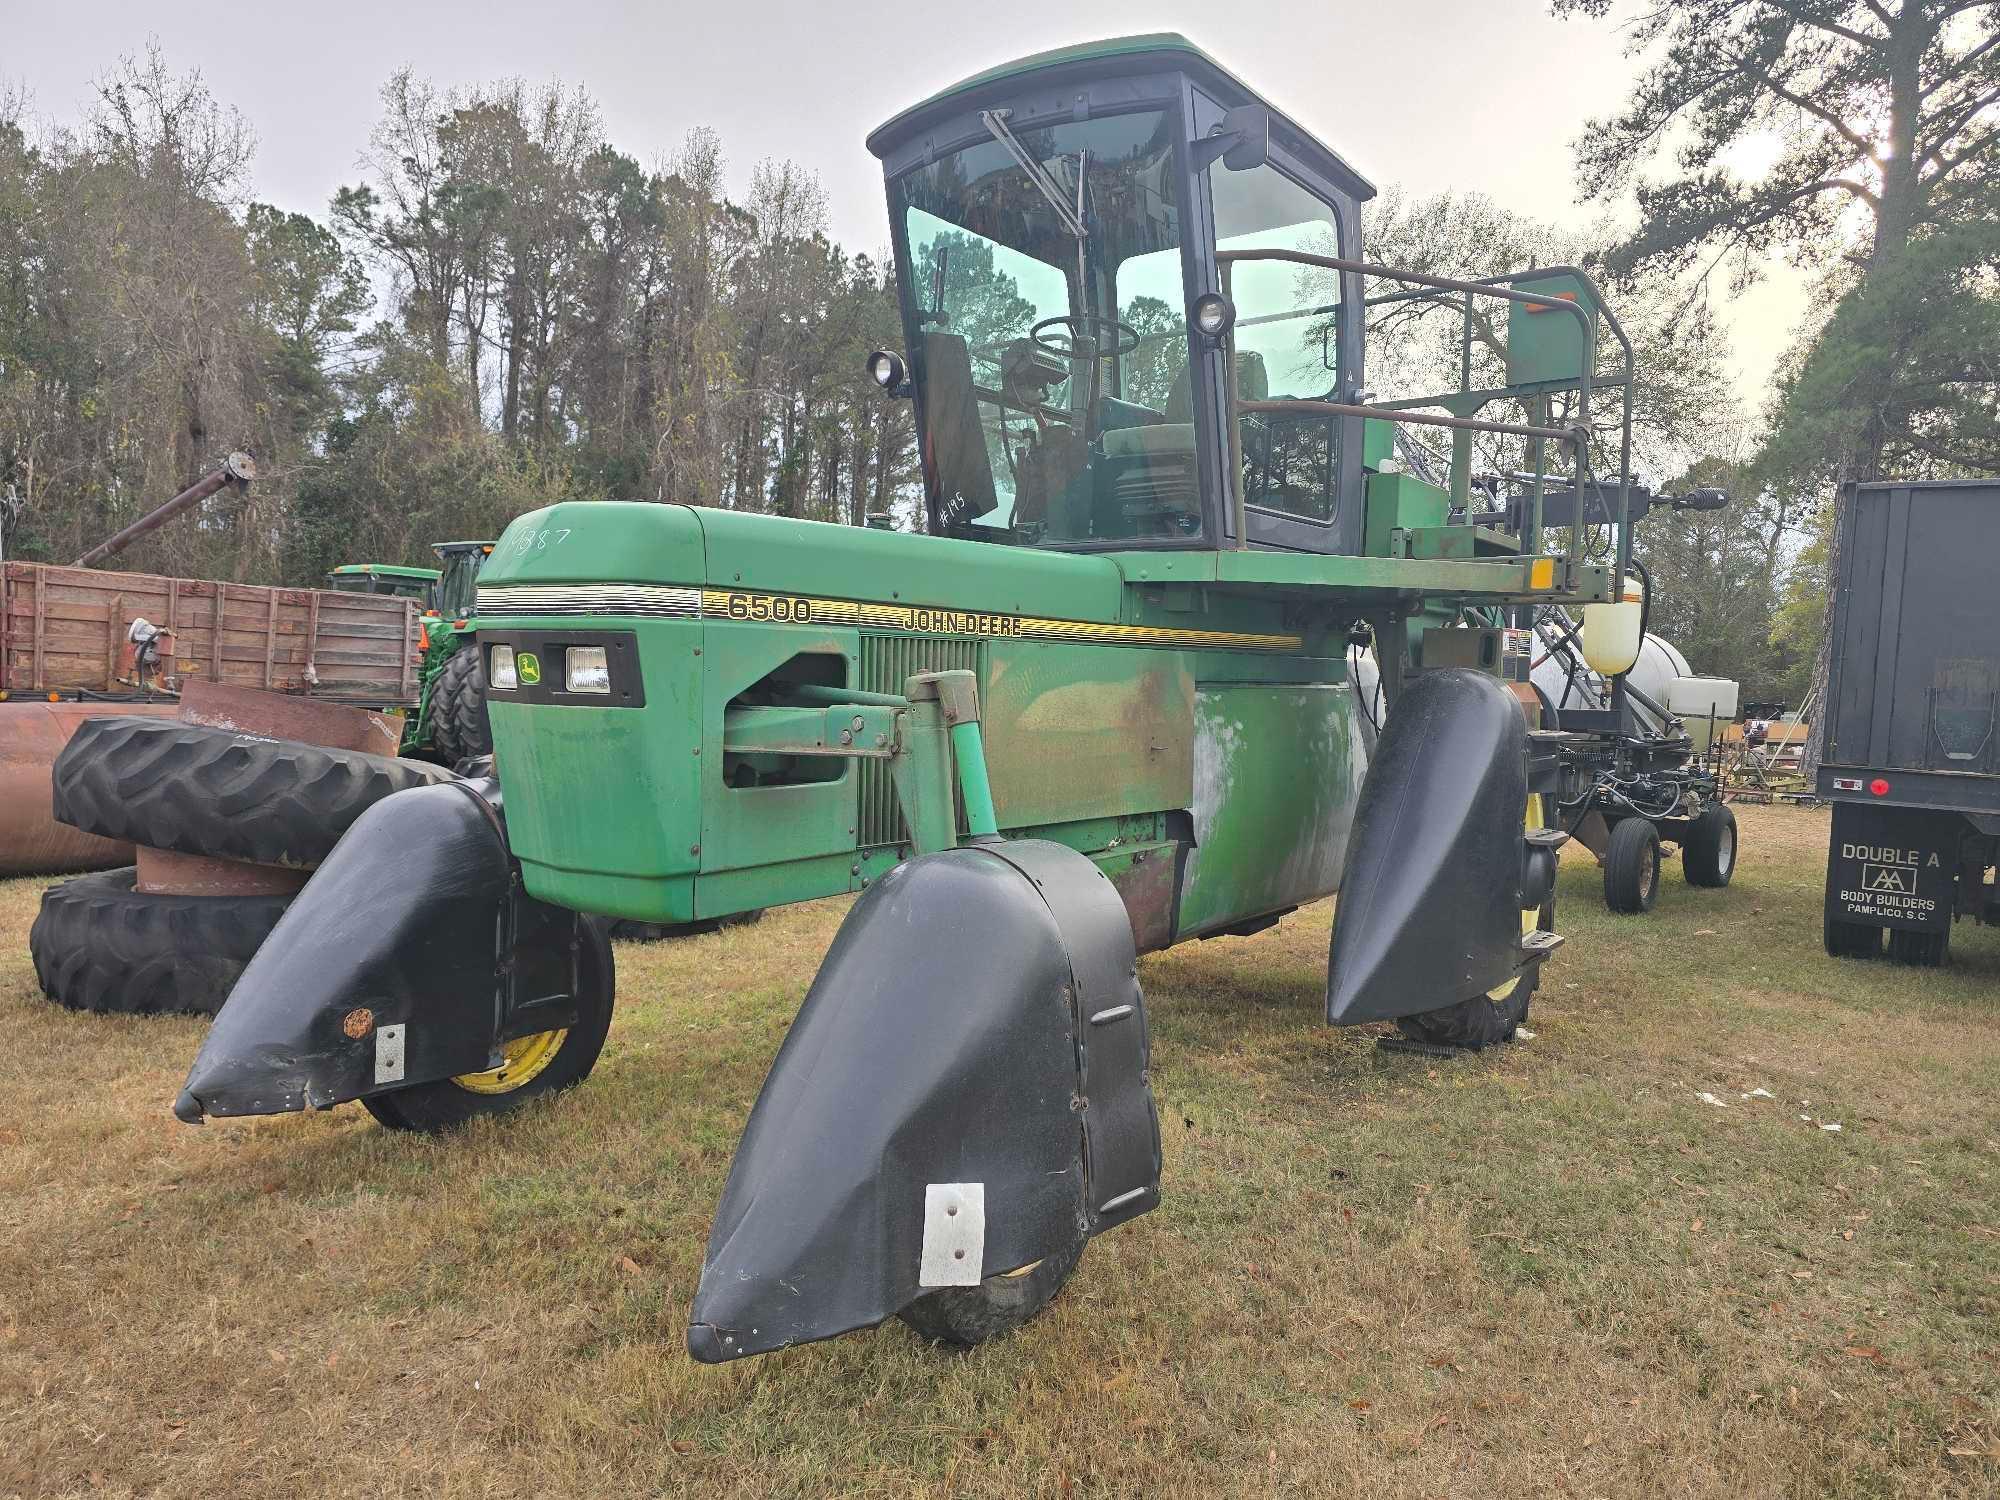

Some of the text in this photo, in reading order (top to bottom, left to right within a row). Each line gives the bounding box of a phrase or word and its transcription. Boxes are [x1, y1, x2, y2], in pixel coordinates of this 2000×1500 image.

[728, 593, 811, 623] 6500
[903, 608, 1021, 638] JOHN DEERE
[1842, 843, 1940, 868] DOUBLE A
[1840, 890, 1935, 911] BODY BUILDERS
[1906, 911, 1928, 921] S.C.
